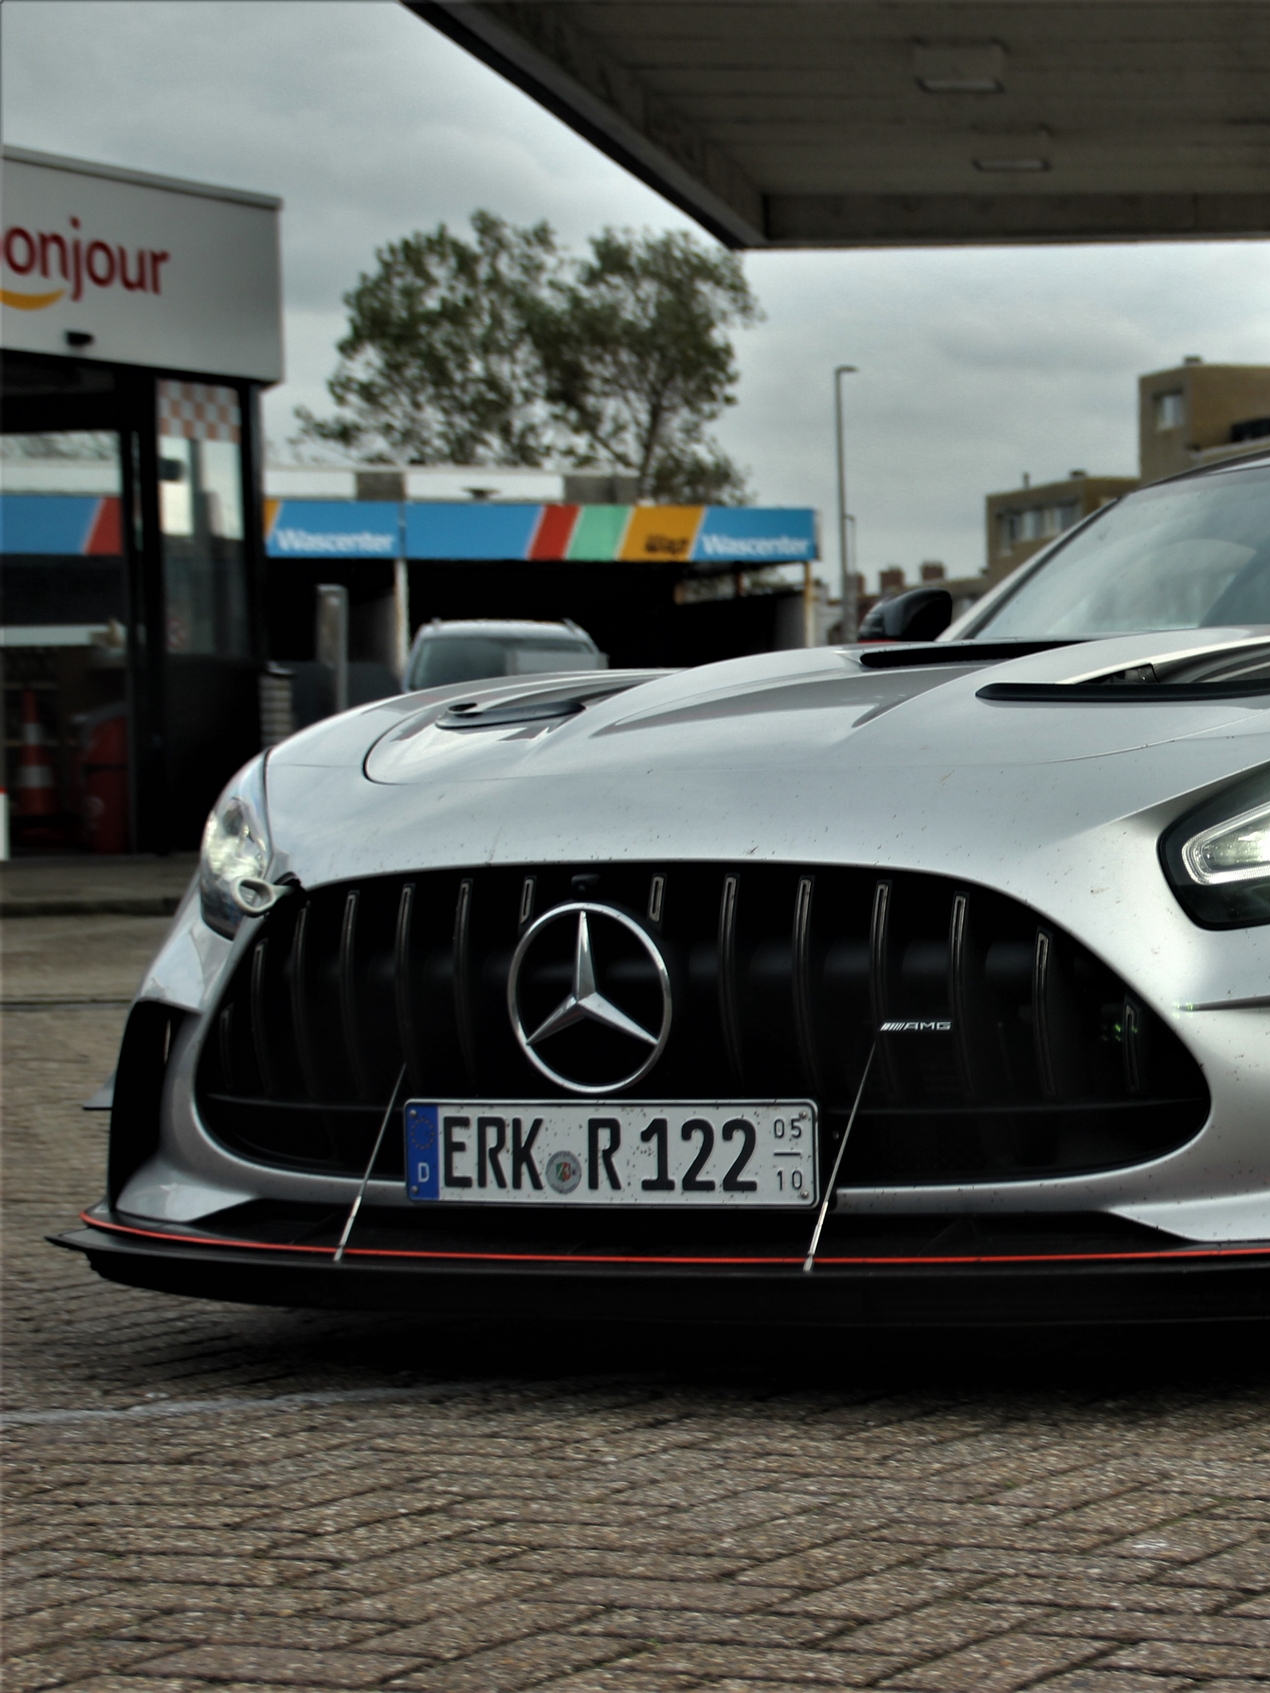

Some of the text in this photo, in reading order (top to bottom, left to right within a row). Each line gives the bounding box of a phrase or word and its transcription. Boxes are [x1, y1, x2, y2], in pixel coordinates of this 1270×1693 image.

[0, 214, 169, 301] onjour
[276, 528, 395, 552] Wascenter
[702, 532, 809, 556] Wascenter
[774, 1118, 802, 1138] 05
[443, 1115, 758, 1192] ERK R 122
[417, 1162, 429, 1183] D
[777, 1170, 803, 1190] 10
